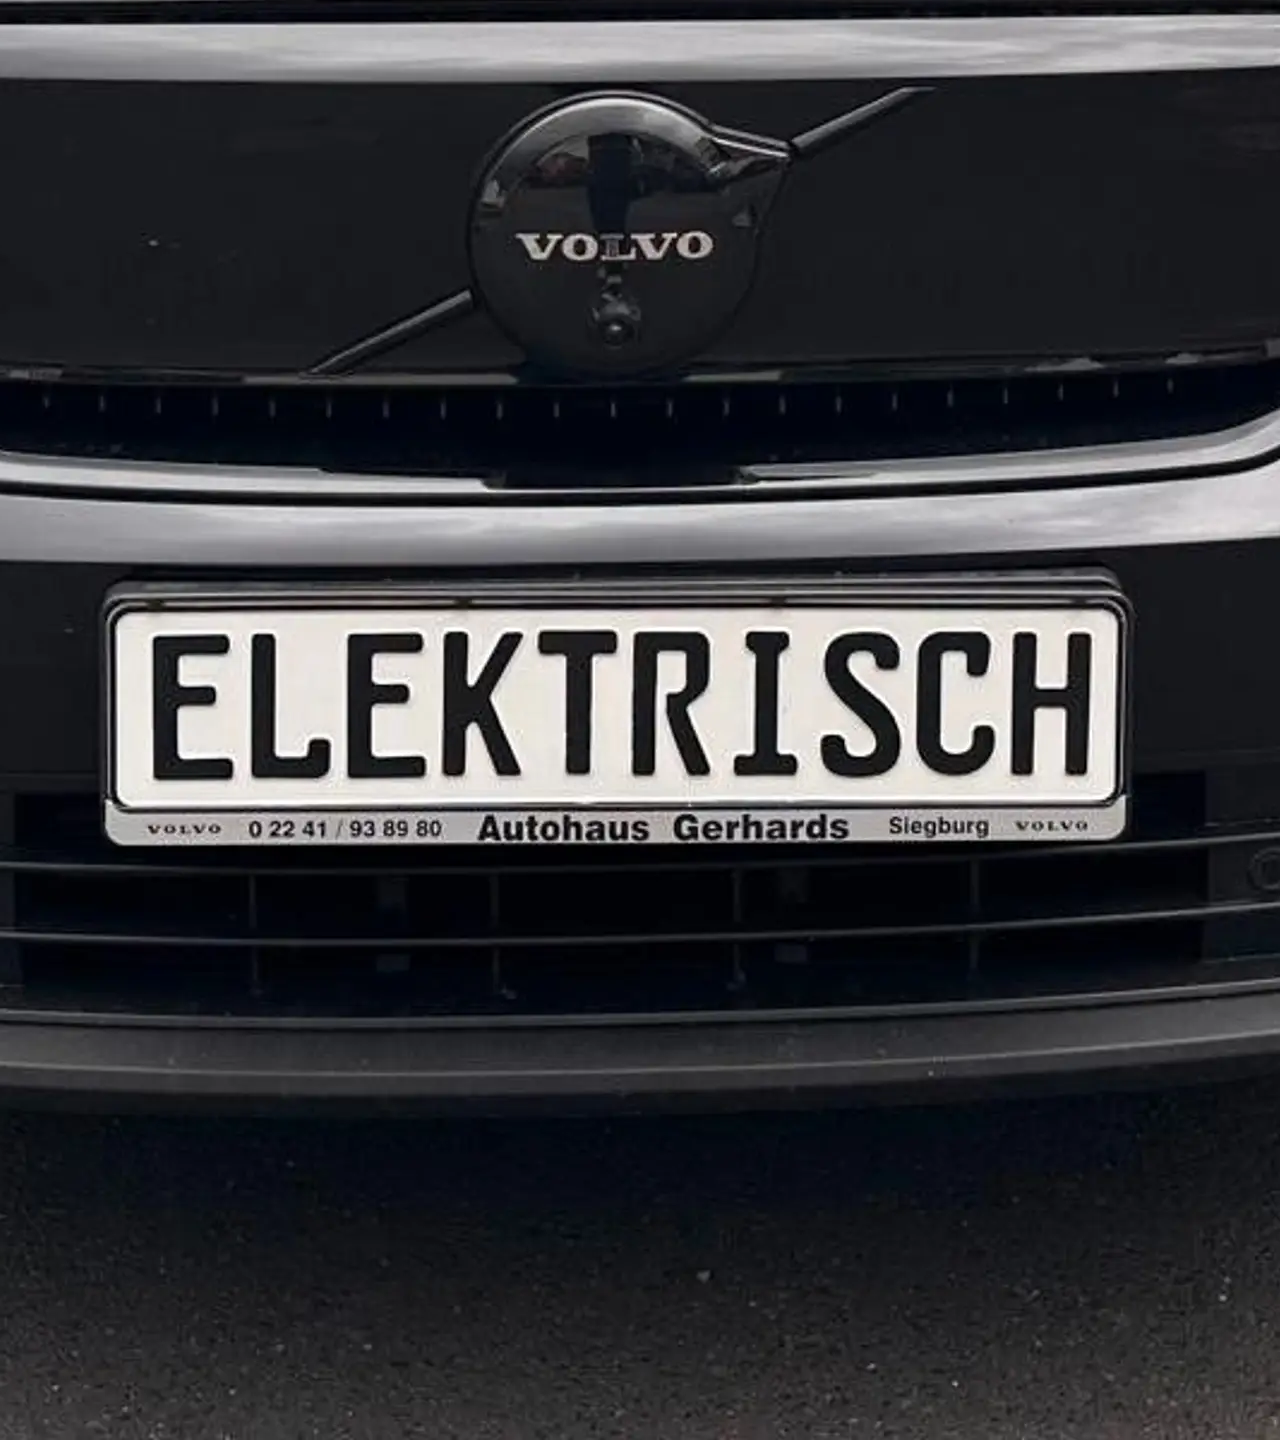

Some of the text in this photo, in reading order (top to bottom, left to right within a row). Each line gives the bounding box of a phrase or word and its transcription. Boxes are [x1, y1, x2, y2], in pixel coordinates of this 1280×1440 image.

[515, 230, 714, 261] VOLVO
[152, 630, 1093, 781] ELEKTRISCH
[146, 823, 223, 836] VOLVO
[248, 819, 263, 839] 0
[269, 819, 296, 839] 22
[301, 819, 327, 839] 41
[349, 819, 376, 838] 93
[382, 819, 409, 838] 89
[415, 819, 443, 838] 80
[477, 814, 650, 843] Autohaus
[671, 813, 851, 843] Gerhards
[889, 815, 990, 839] Siegburg
[1015, 819, 1090, 832] VOLVO
